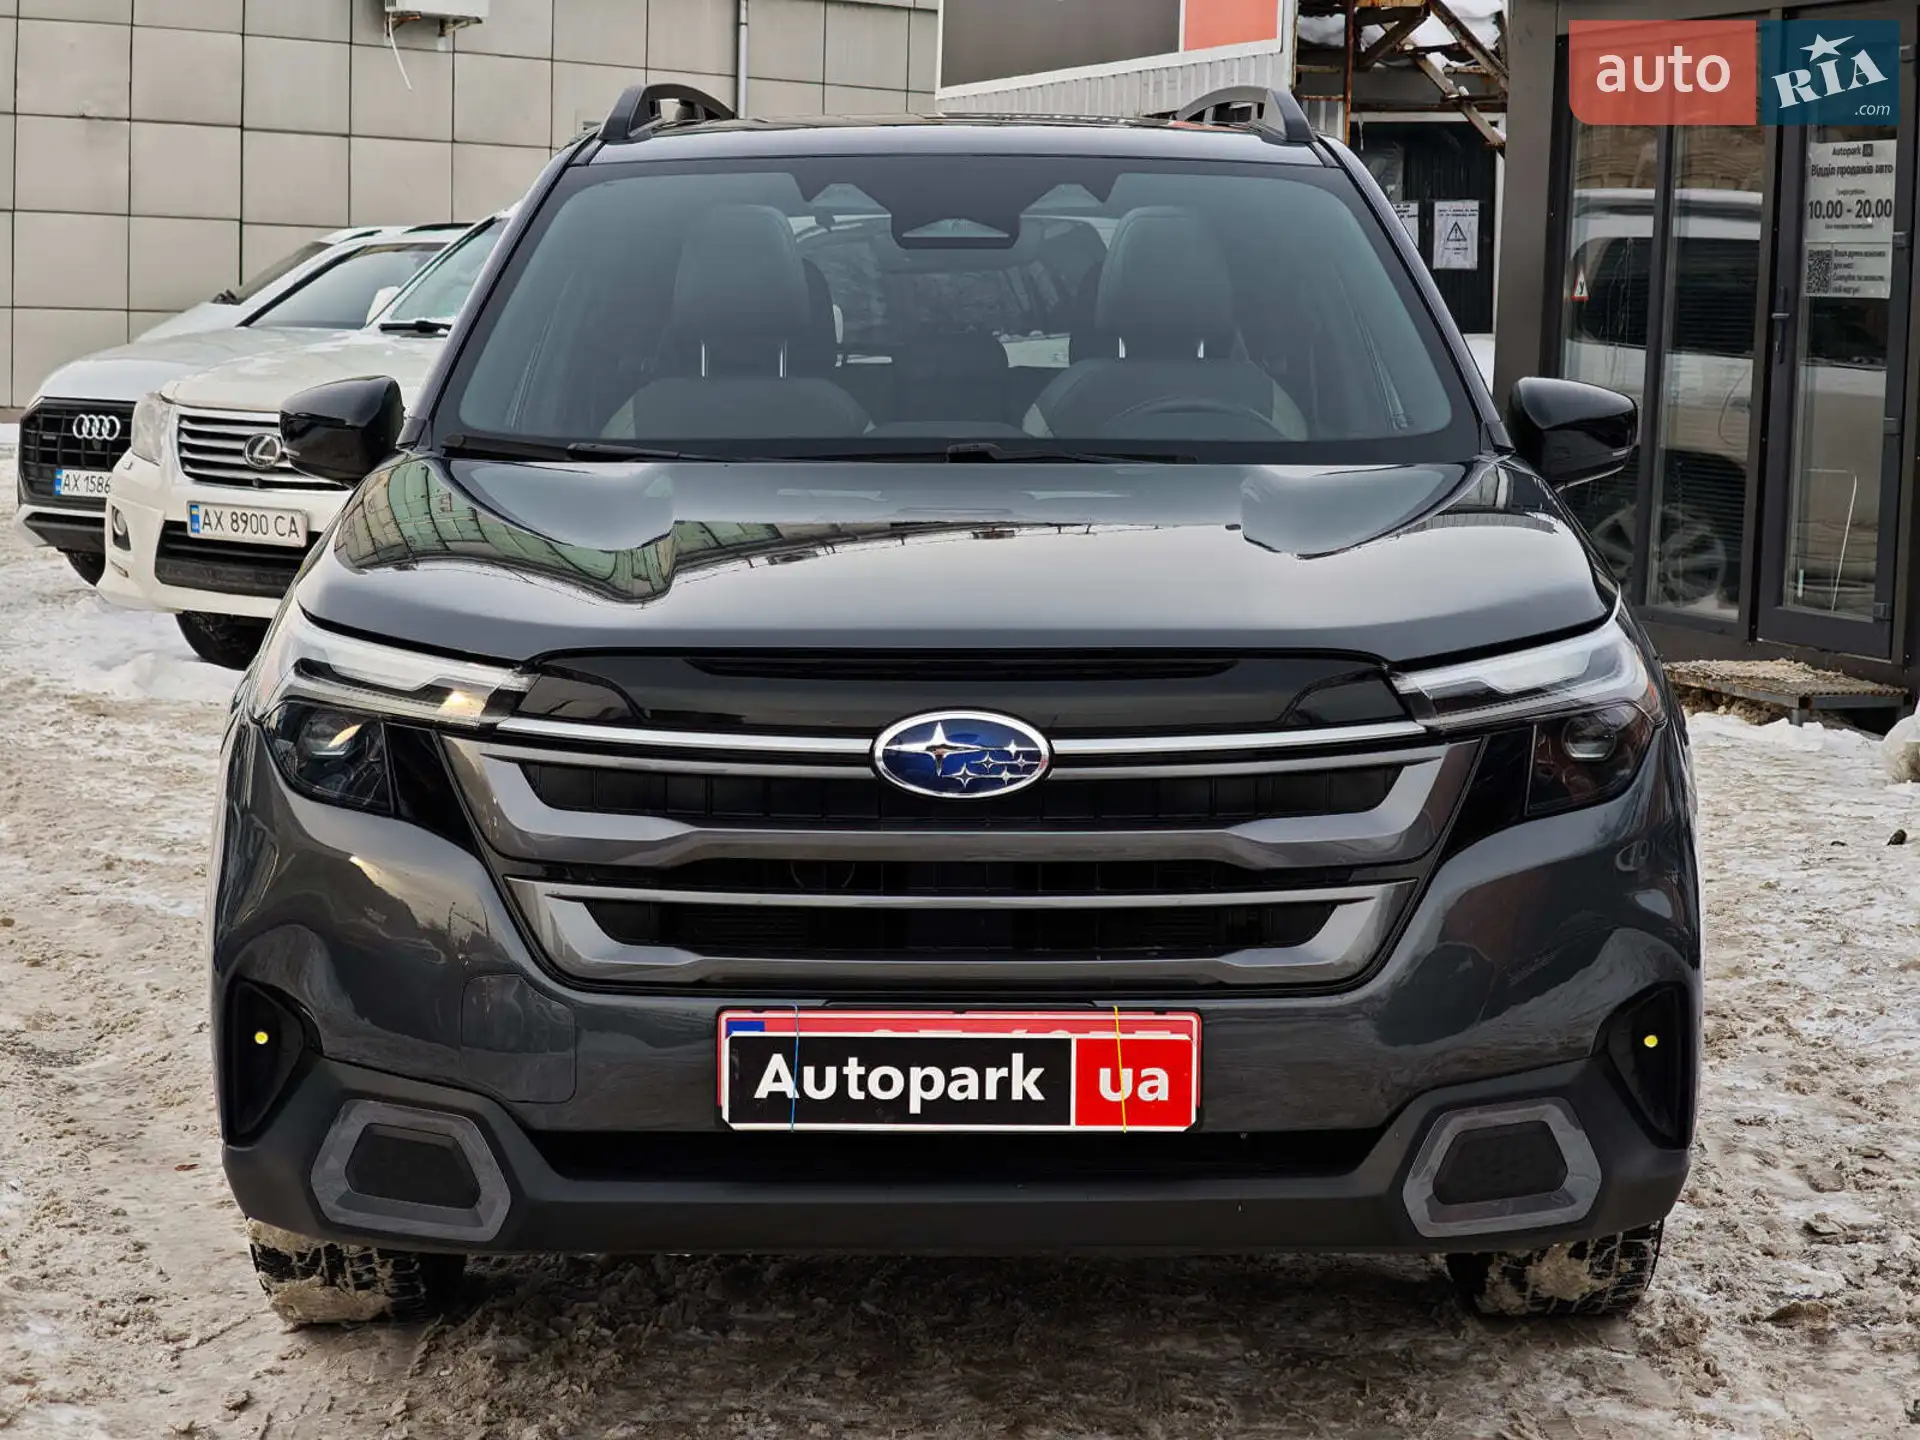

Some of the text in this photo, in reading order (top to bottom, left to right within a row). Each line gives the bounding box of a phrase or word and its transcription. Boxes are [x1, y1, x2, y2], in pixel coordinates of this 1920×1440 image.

[1832, 145, 1861, 157] Autopark
[1809, 200, 1843, 219] 10.00
[1855, 199, 1892, 219] 20.00
[63, 474, 111, 494] AX 1586
[202, 508, 299, 538] AX 8900 CA
[754, 1053, 1170, 1115] Autopark ua
